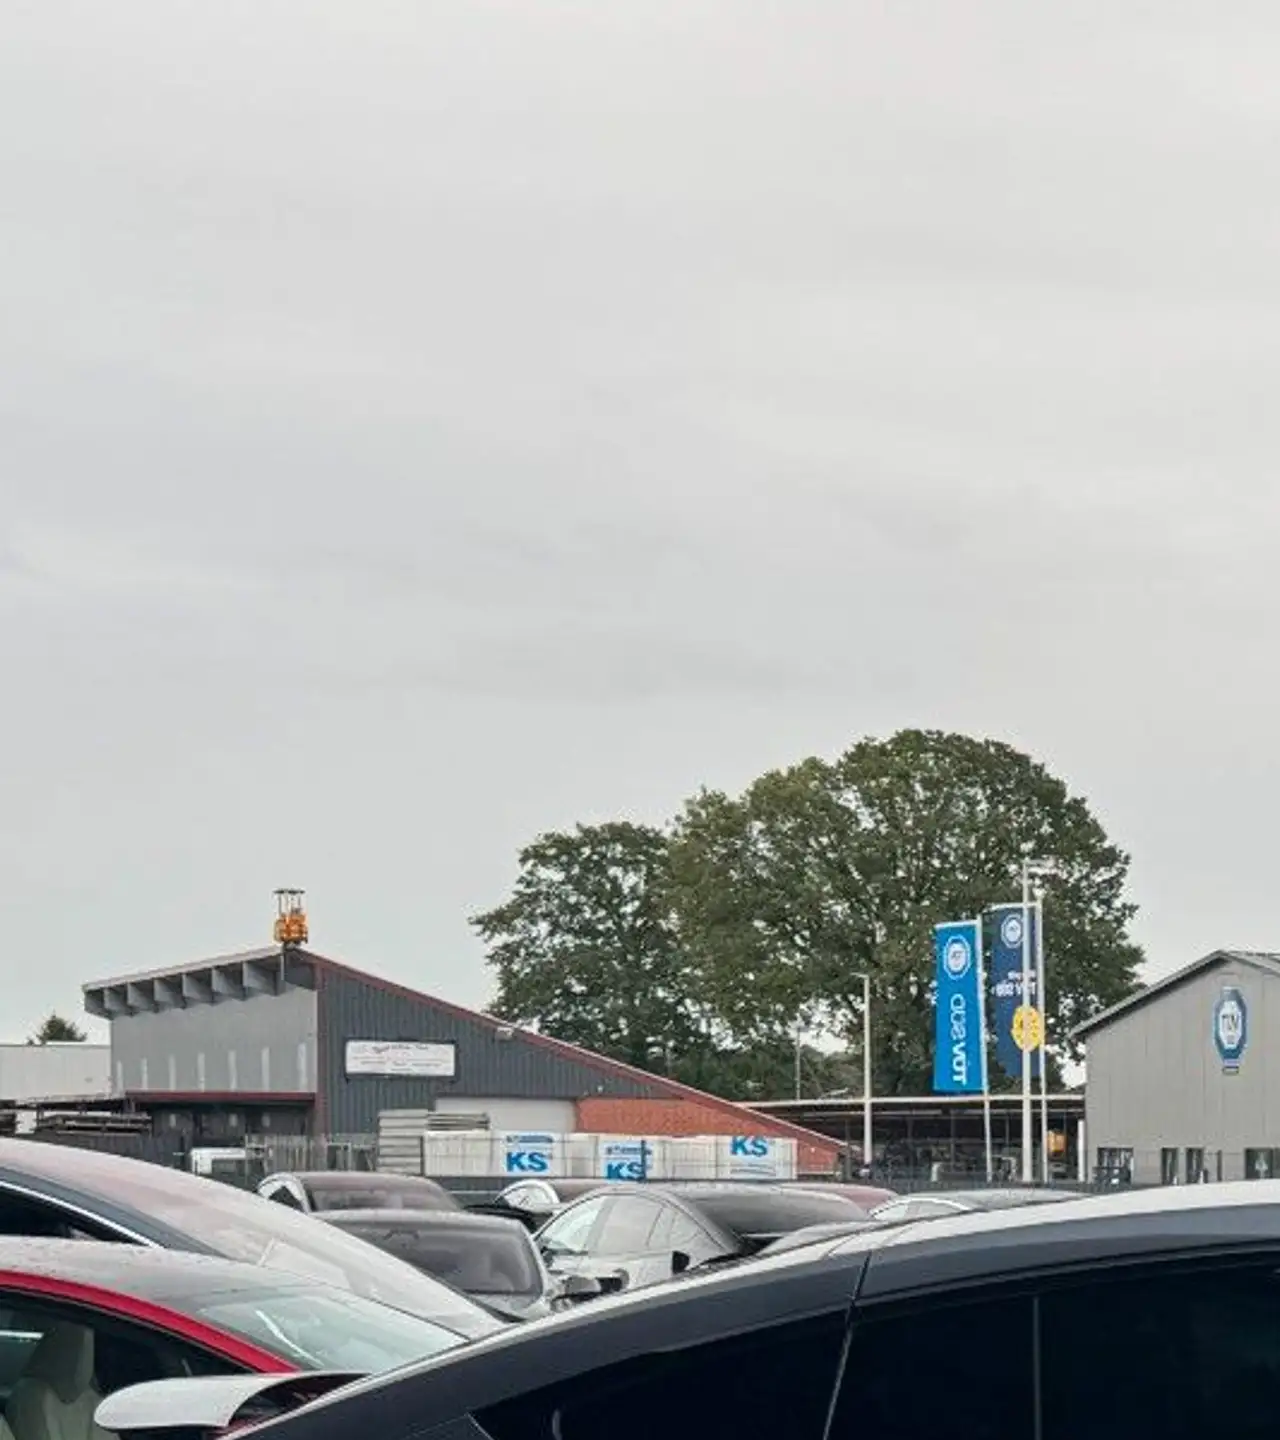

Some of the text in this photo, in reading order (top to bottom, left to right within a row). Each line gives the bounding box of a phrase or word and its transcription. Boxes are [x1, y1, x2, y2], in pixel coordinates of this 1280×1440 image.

[731, 1136, 768, 1157] KS
[506, 1151, 548, 1172] KS
[606, 1161, 645, 1181] KS
